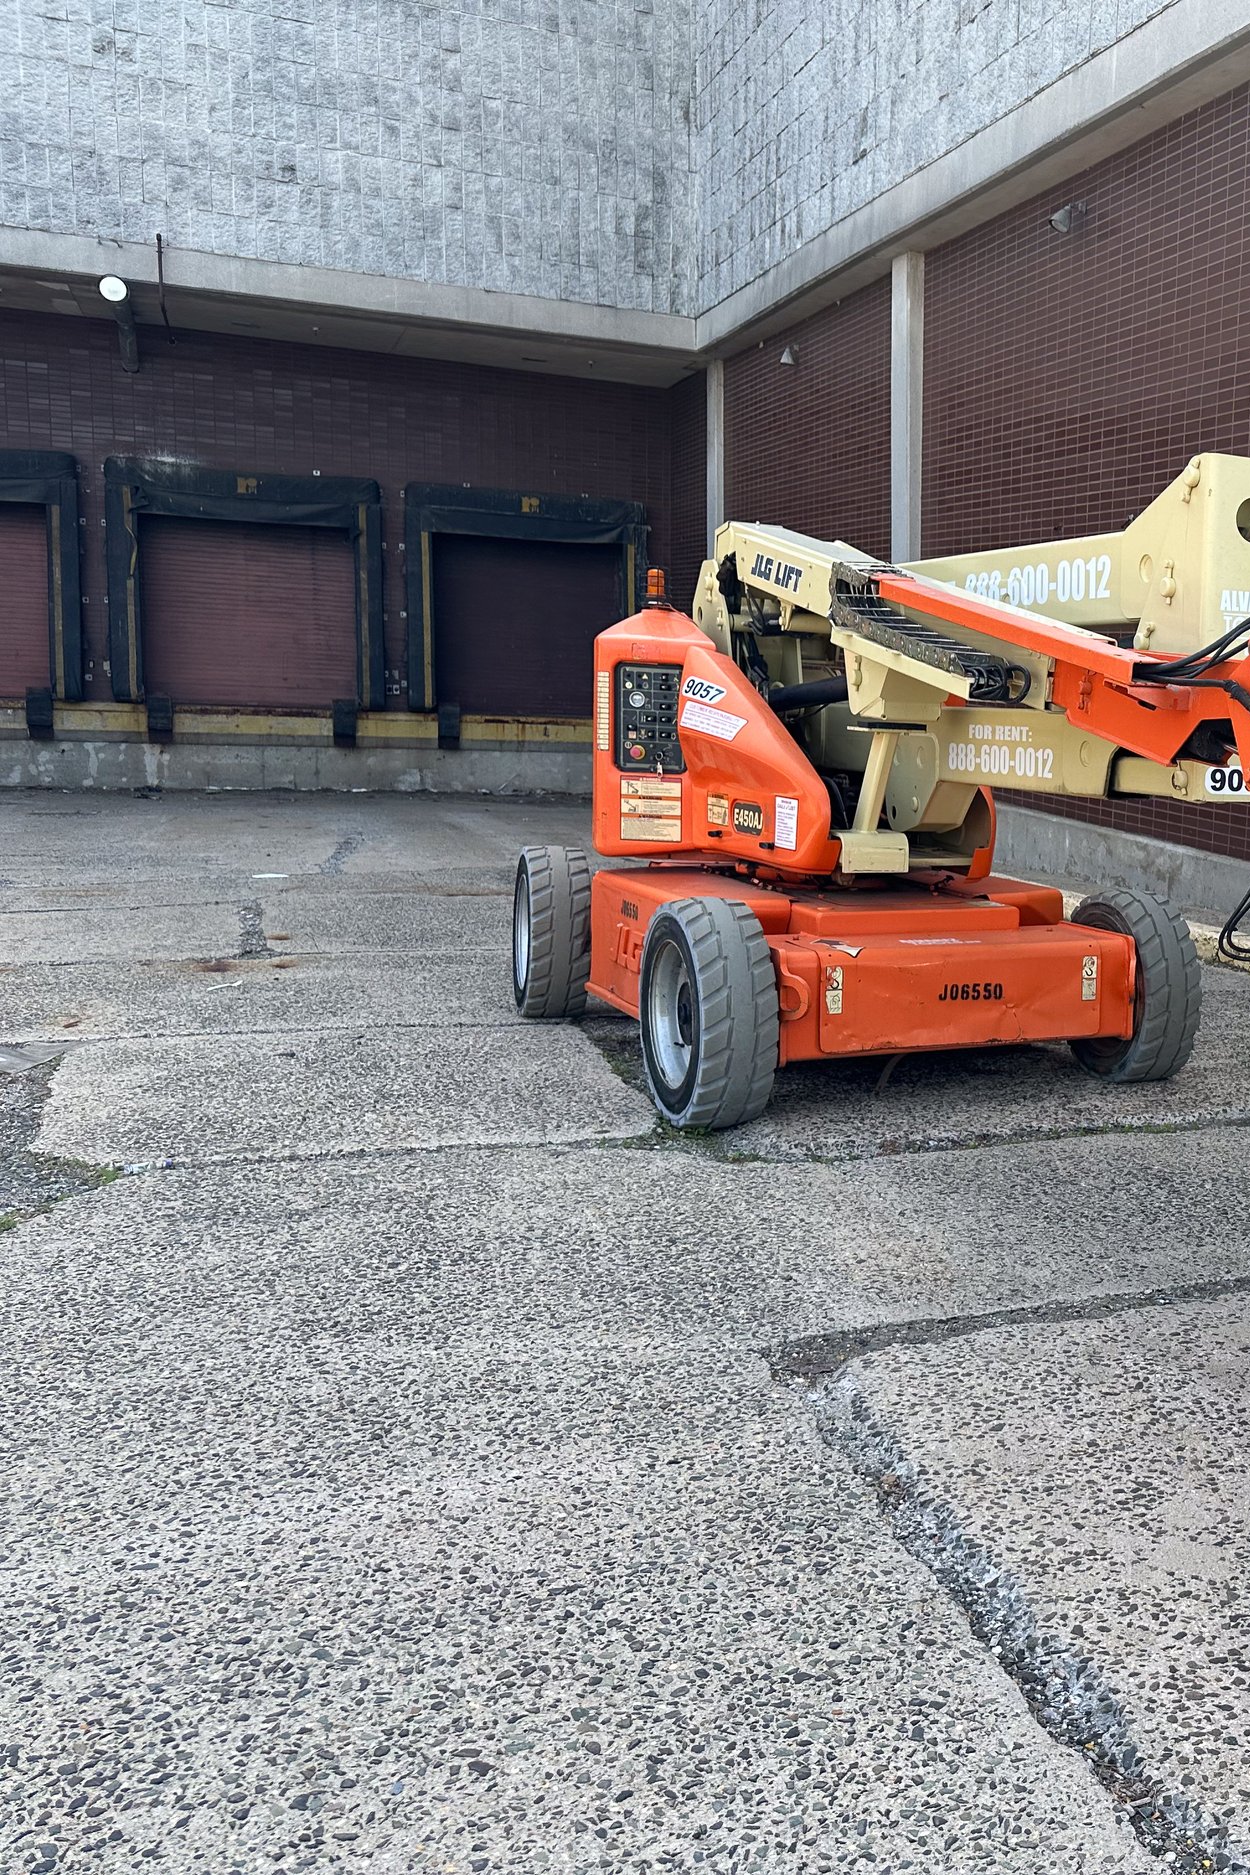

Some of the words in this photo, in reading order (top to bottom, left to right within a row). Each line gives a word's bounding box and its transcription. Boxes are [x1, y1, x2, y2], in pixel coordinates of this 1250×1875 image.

[751, 553, 774, 581] JLG
[774, 562, 803, 592] LIFT
[684, 678, 725, 701] 9057
[968, 724, 992, 740] FOR
[995, 725, 1032, 742] RENT:
[948, 742, 1054, 779] 888-600-0012
[1210, 768, 1249, 792] 90
[734, 808, 763, 830] E450AJ
[938, 982, 1003, 1001] J06550
